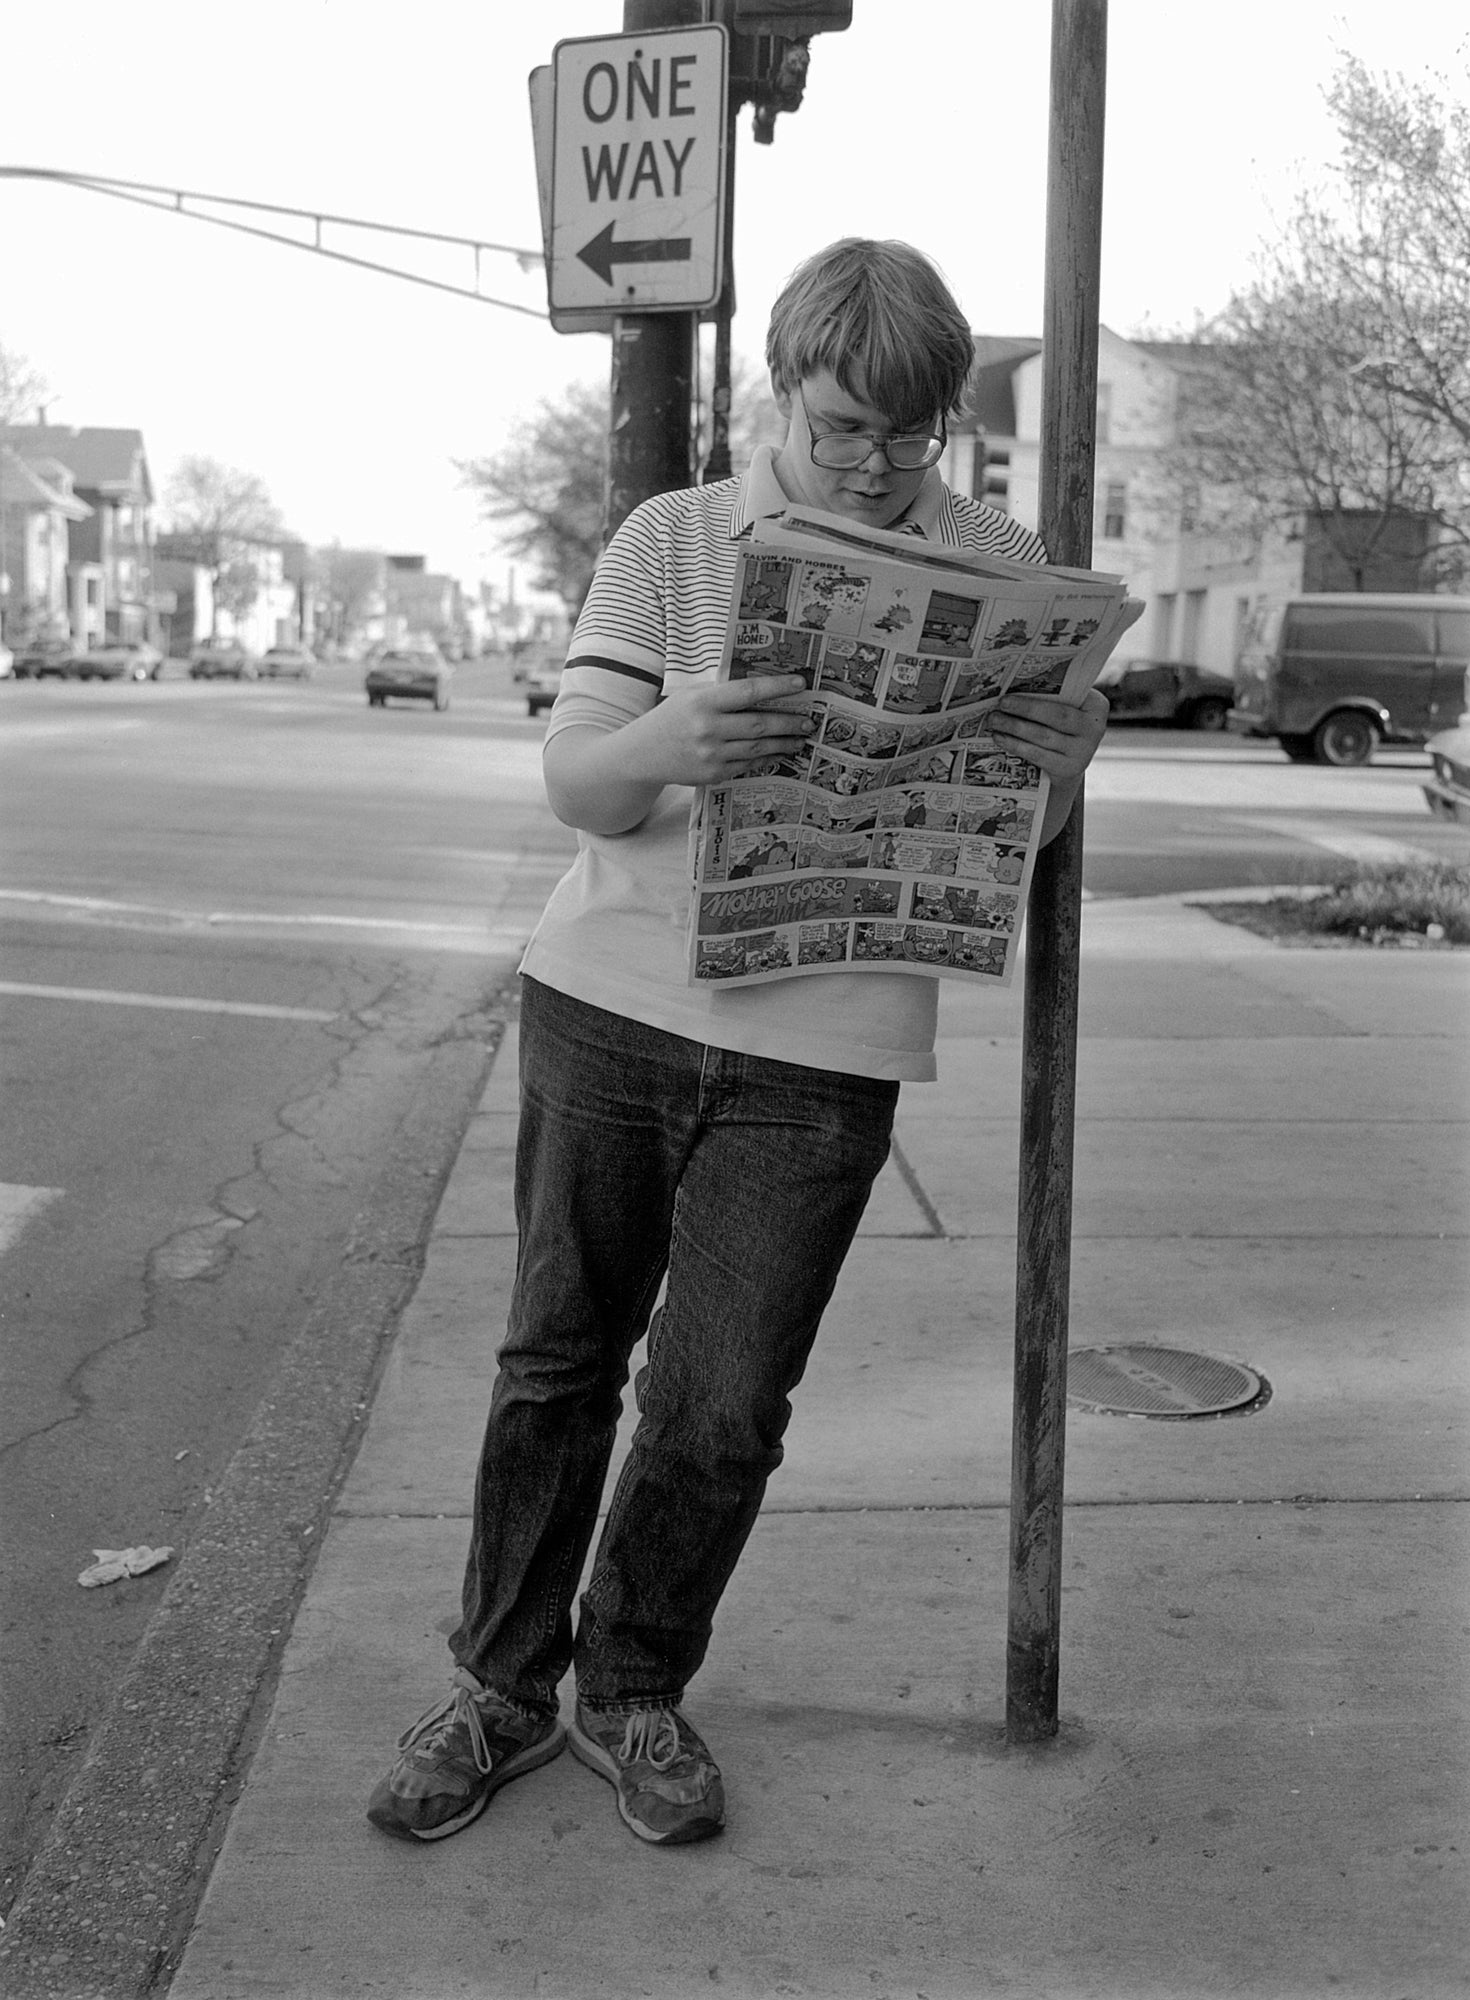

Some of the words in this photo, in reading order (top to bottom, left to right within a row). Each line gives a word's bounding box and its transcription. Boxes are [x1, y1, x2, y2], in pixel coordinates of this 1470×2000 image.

[582, 55, 697, 123] ONE
[581, 137, 696, 202] WAY
[742, 552, 778, 561] CALVIN
[781, 555, 802, 564] AND
[805, 560, 846, 571] HOBBES
[737, 634, 769, 645] HOME!
[742, 623, 760, 634] I'M
[702, 885, 784, 918] Mother
[787, 877, 848, 904] Goose
